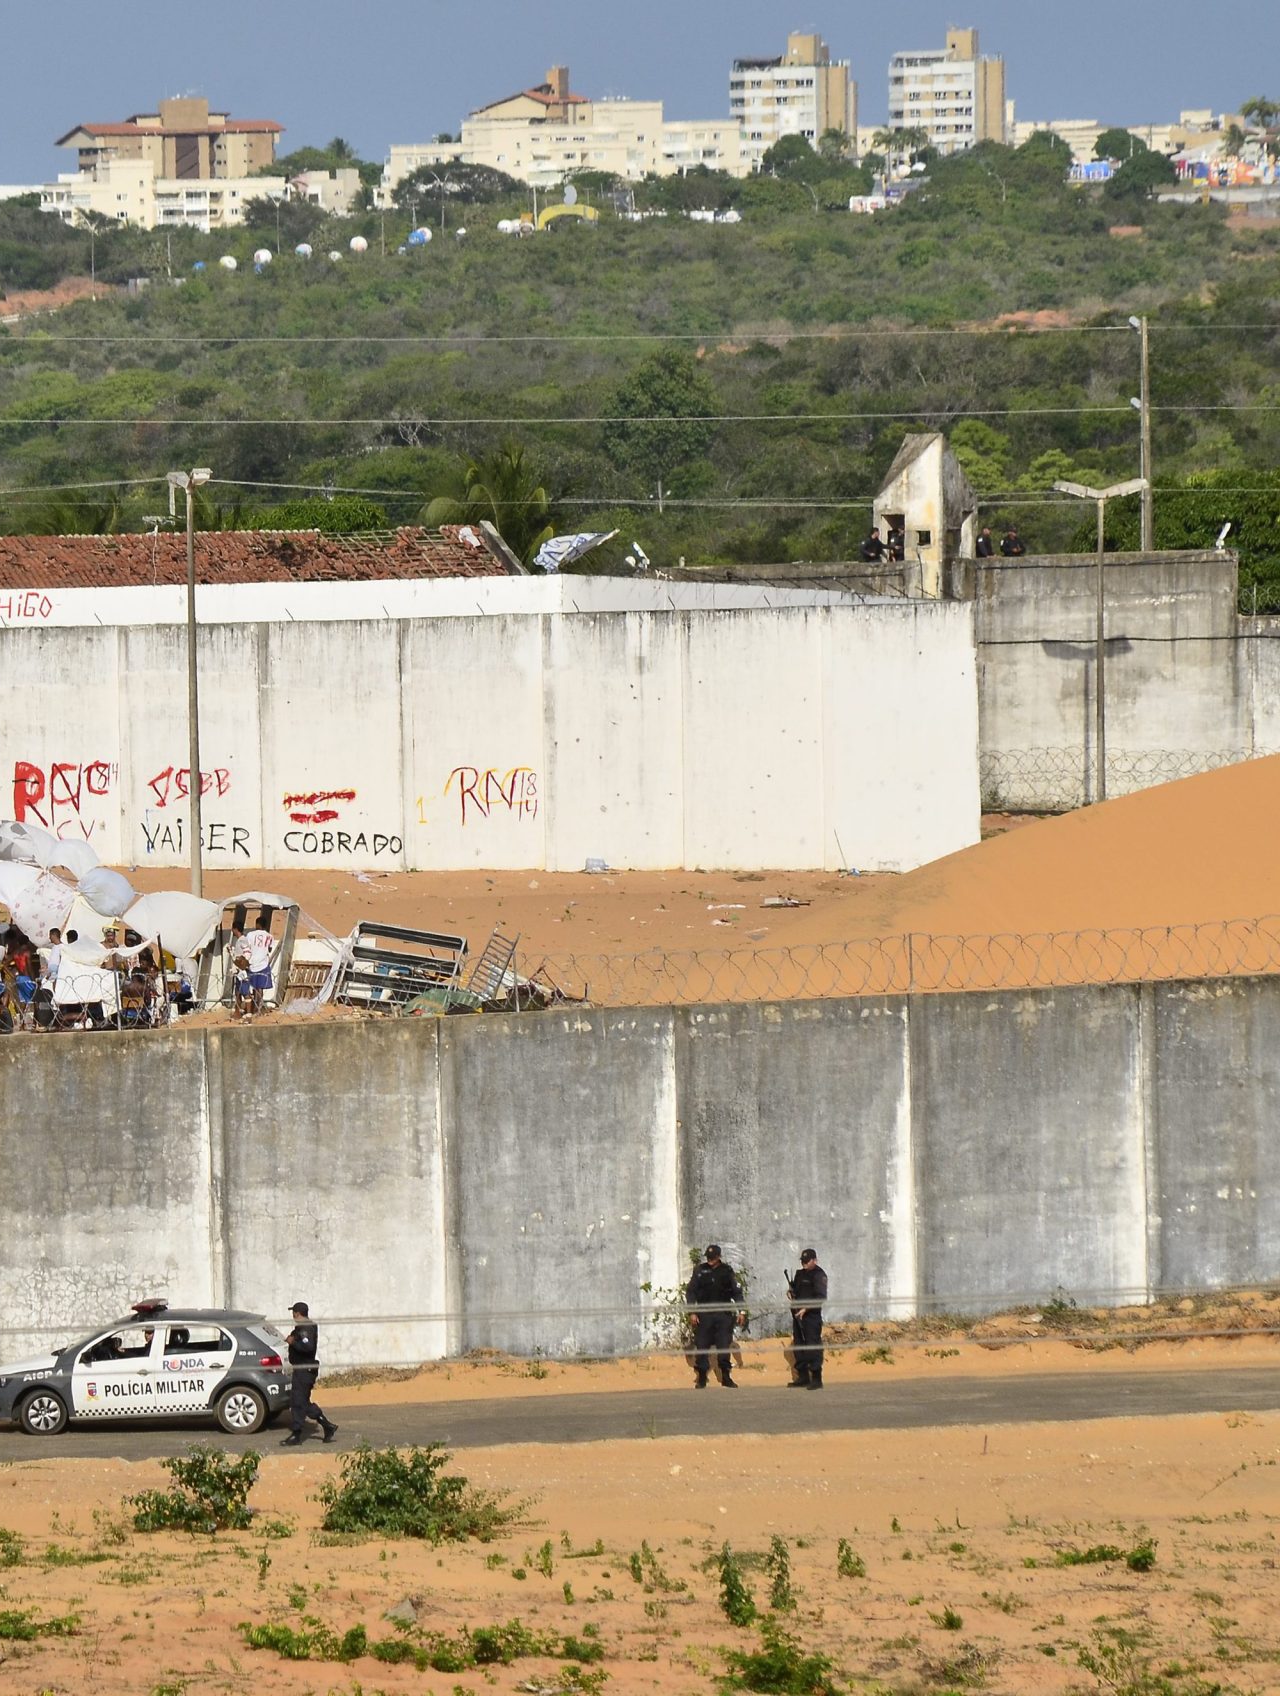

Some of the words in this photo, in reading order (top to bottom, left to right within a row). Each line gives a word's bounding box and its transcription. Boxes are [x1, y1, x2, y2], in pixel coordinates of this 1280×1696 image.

[283, 830, 404, 856] COBRADO
[104, 1379, 153, 1398] POLÍCIA
[156, 1379, 205, 1395] MILITAR
